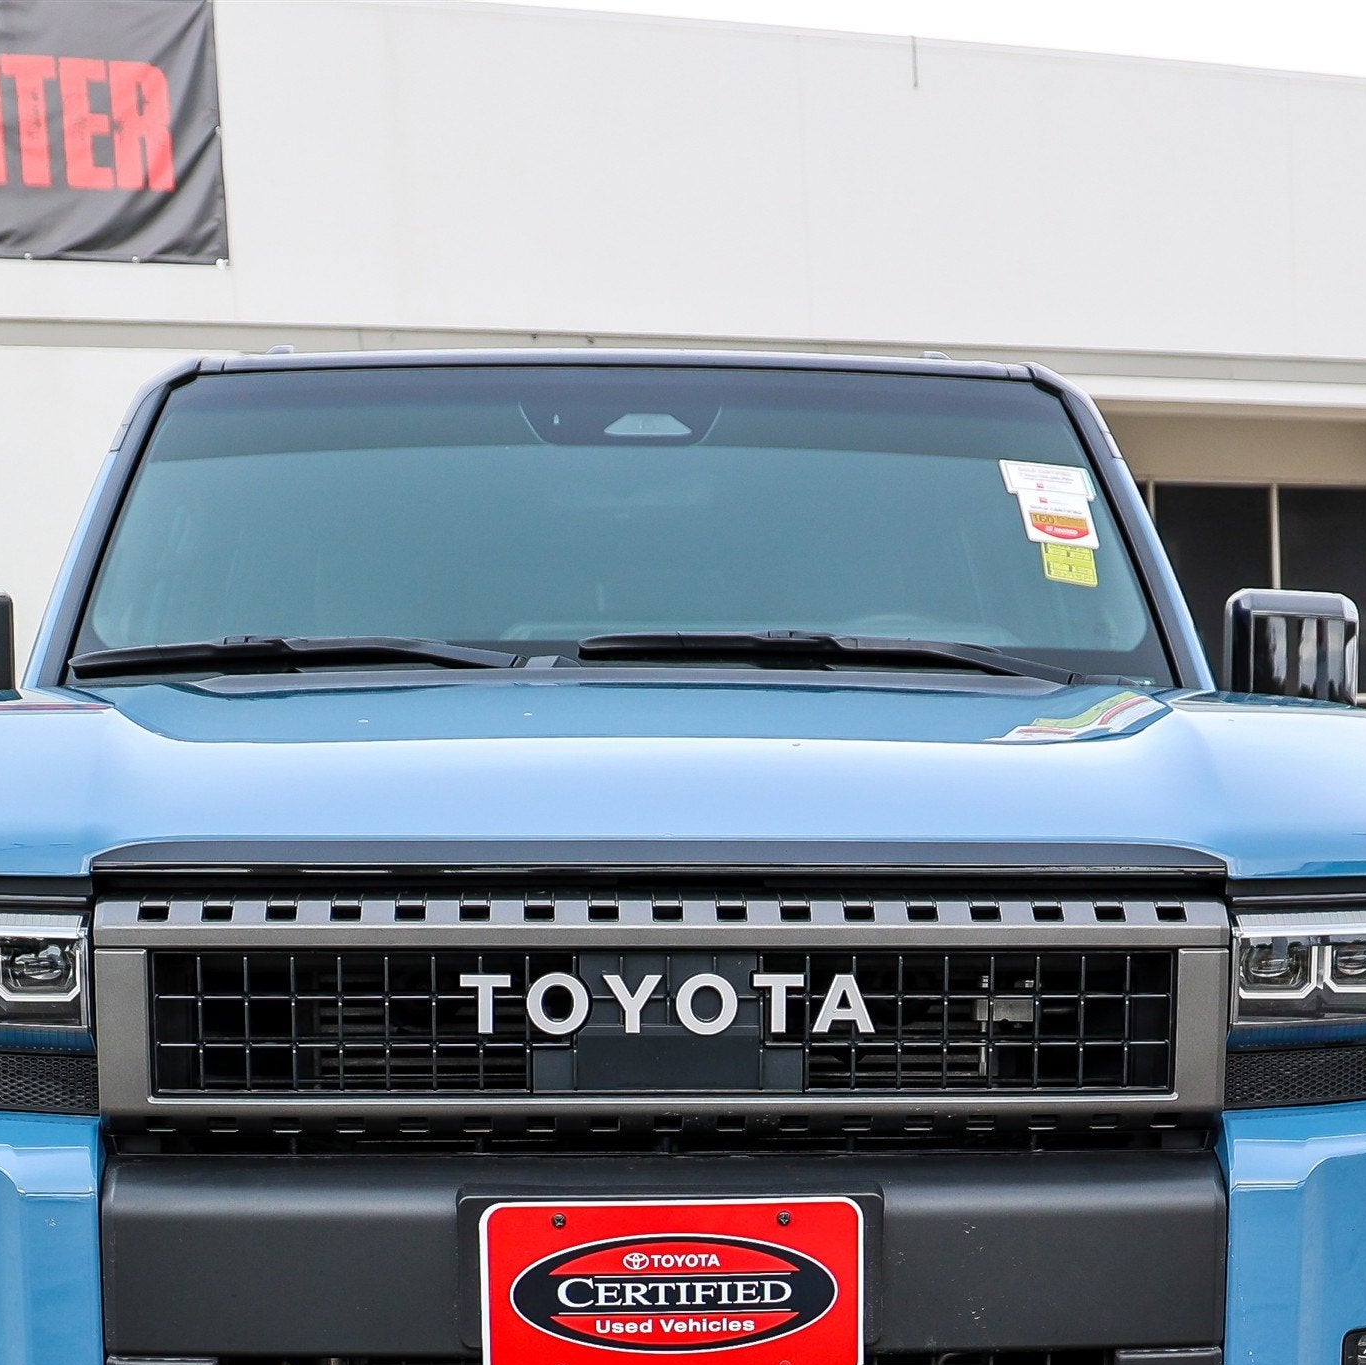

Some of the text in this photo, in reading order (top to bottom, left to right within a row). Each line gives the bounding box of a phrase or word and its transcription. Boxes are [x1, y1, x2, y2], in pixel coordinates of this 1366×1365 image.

[459, 972, 875, 1036] TOYOTA
[650, 1253, 721, 1268] TOYOTA
[557, 1277, 792, 1308] CERTIFIED
[595, 1317, 756, 1334] Used Vehicles
